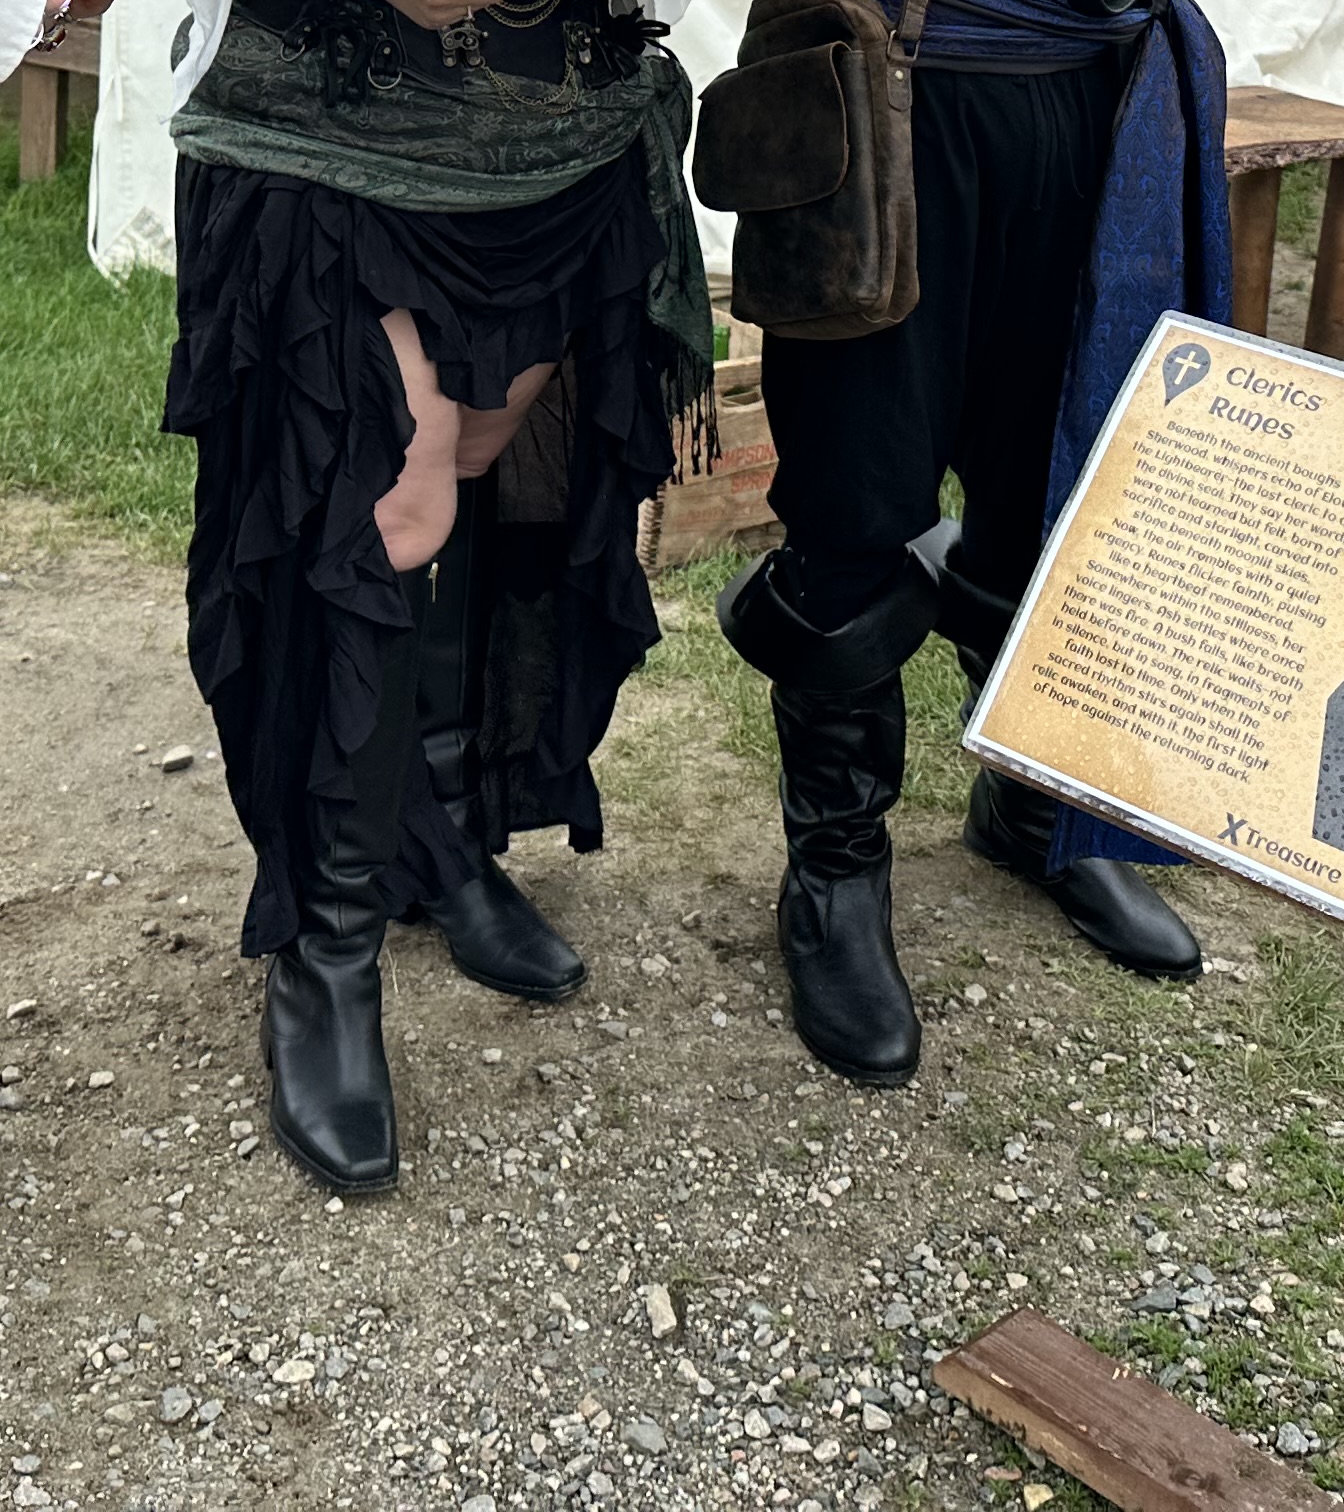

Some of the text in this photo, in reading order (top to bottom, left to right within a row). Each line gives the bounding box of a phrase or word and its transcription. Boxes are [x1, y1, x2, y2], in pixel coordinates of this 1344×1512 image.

[1207, 395, 1296, 441] Runes
[1225, 366, 1324, 412] Clerics
[1131, 439, 1155, 457] the
[1254, 483, 1285, 503] last
[1282, 495, 1322, 517] cleric
[1318, 506, 1339, 524] to
[1165, 419, 1219, 448] Beneath
[1219, 437, 1243, 455] the
[1241, 444, 1292, 475] ancient
[1291, 461, 1343, 490] boughs
[1212, 453, 1270, 483] whispers
[1269, 471, 1304, 494] echo
[1303, 486, 1324, 499] of
[1132, 474, 1165, 496] were
[1163, 487, 1189, 503] not
[1186, 493, 1240, 522] learned
[1237, 511, 1263, 531] but
[1288, 530, 1325, 555] born
[1134, 457, 1158, 475] the
[1157, 467, 1196, 491] divine
[1226, 488, 1260, 514] They
[1258, 504, 1285, 523] say
[1283, 511, 1310, 530] her
[1215, 811, 1249, 848] X
[1245, 826, 1343, 885] Treasure
